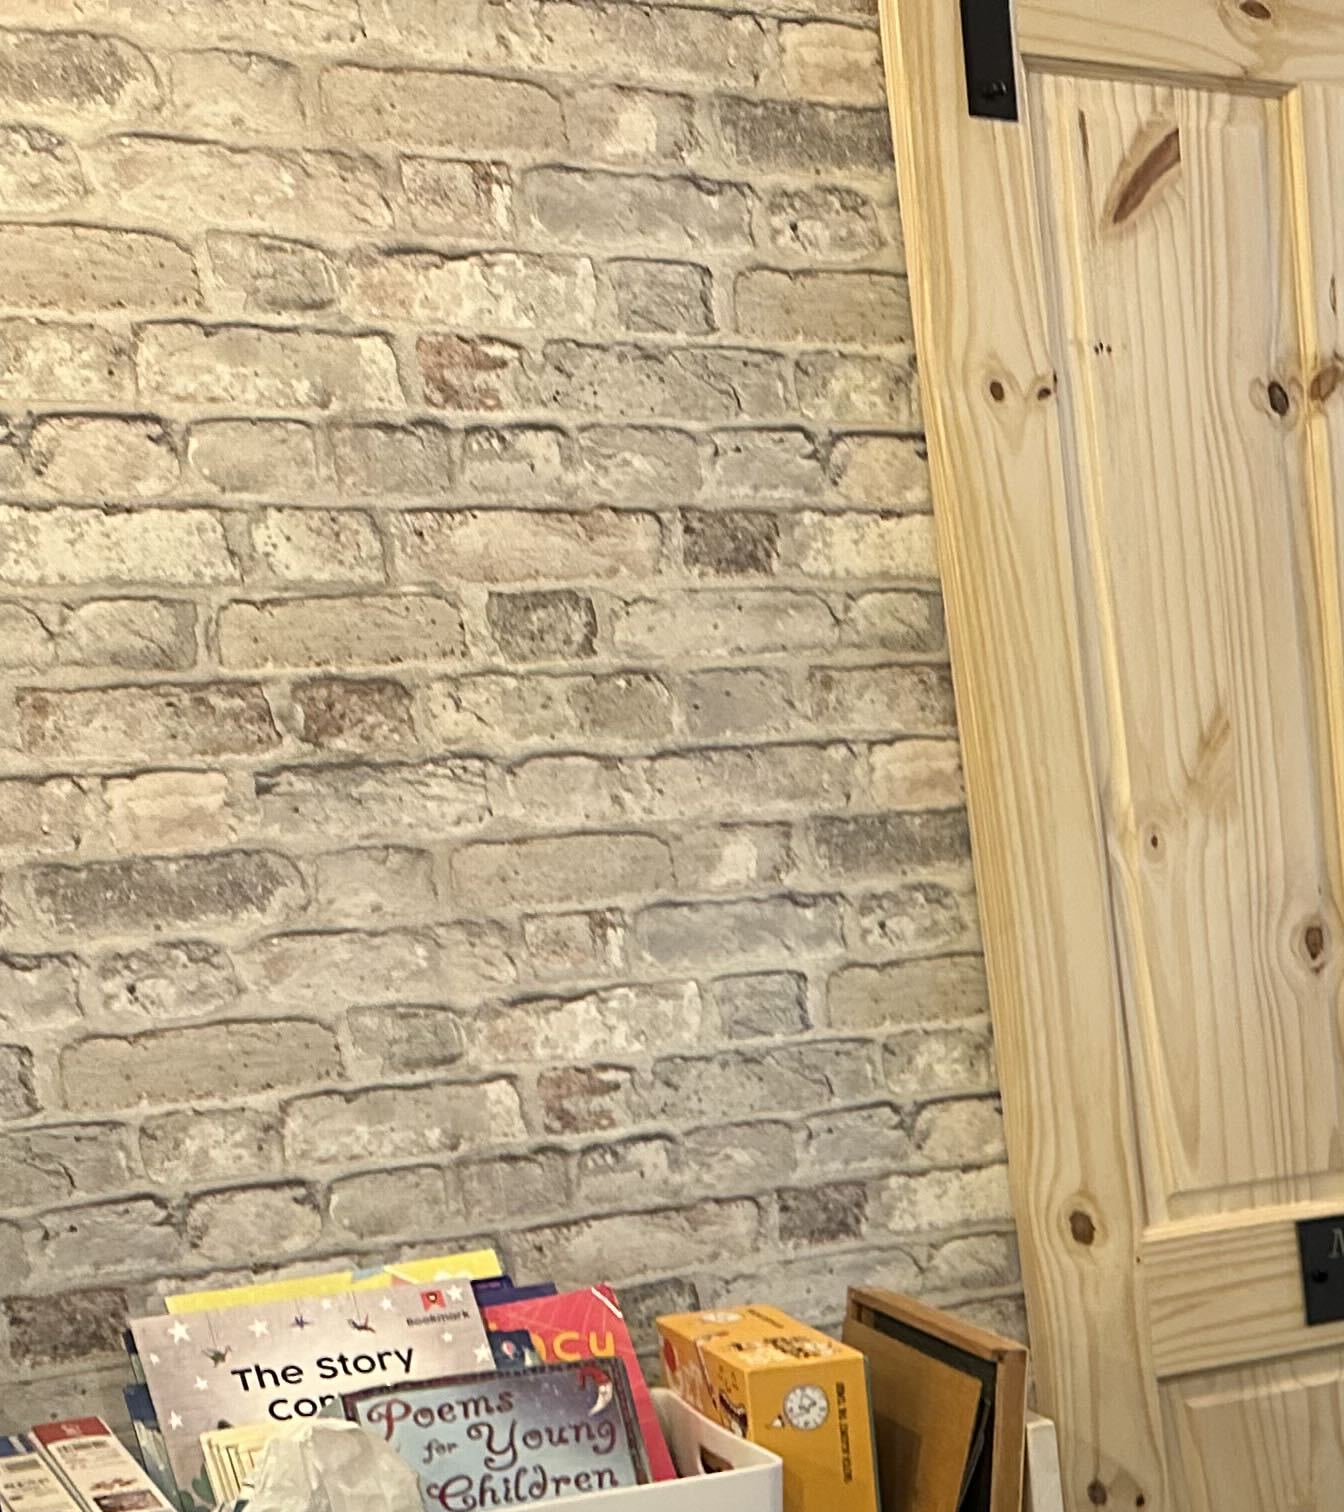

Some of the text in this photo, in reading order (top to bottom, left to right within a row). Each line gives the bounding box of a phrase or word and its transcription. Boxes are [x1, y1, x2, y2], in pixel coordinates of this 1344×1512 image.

[231, 1346, 415, 1393] The Story
[267, 1392, 343, 1423] Cor
[366, 1388, 515, 1439] Poems
[422, 1420, 617, 1471] for Young
